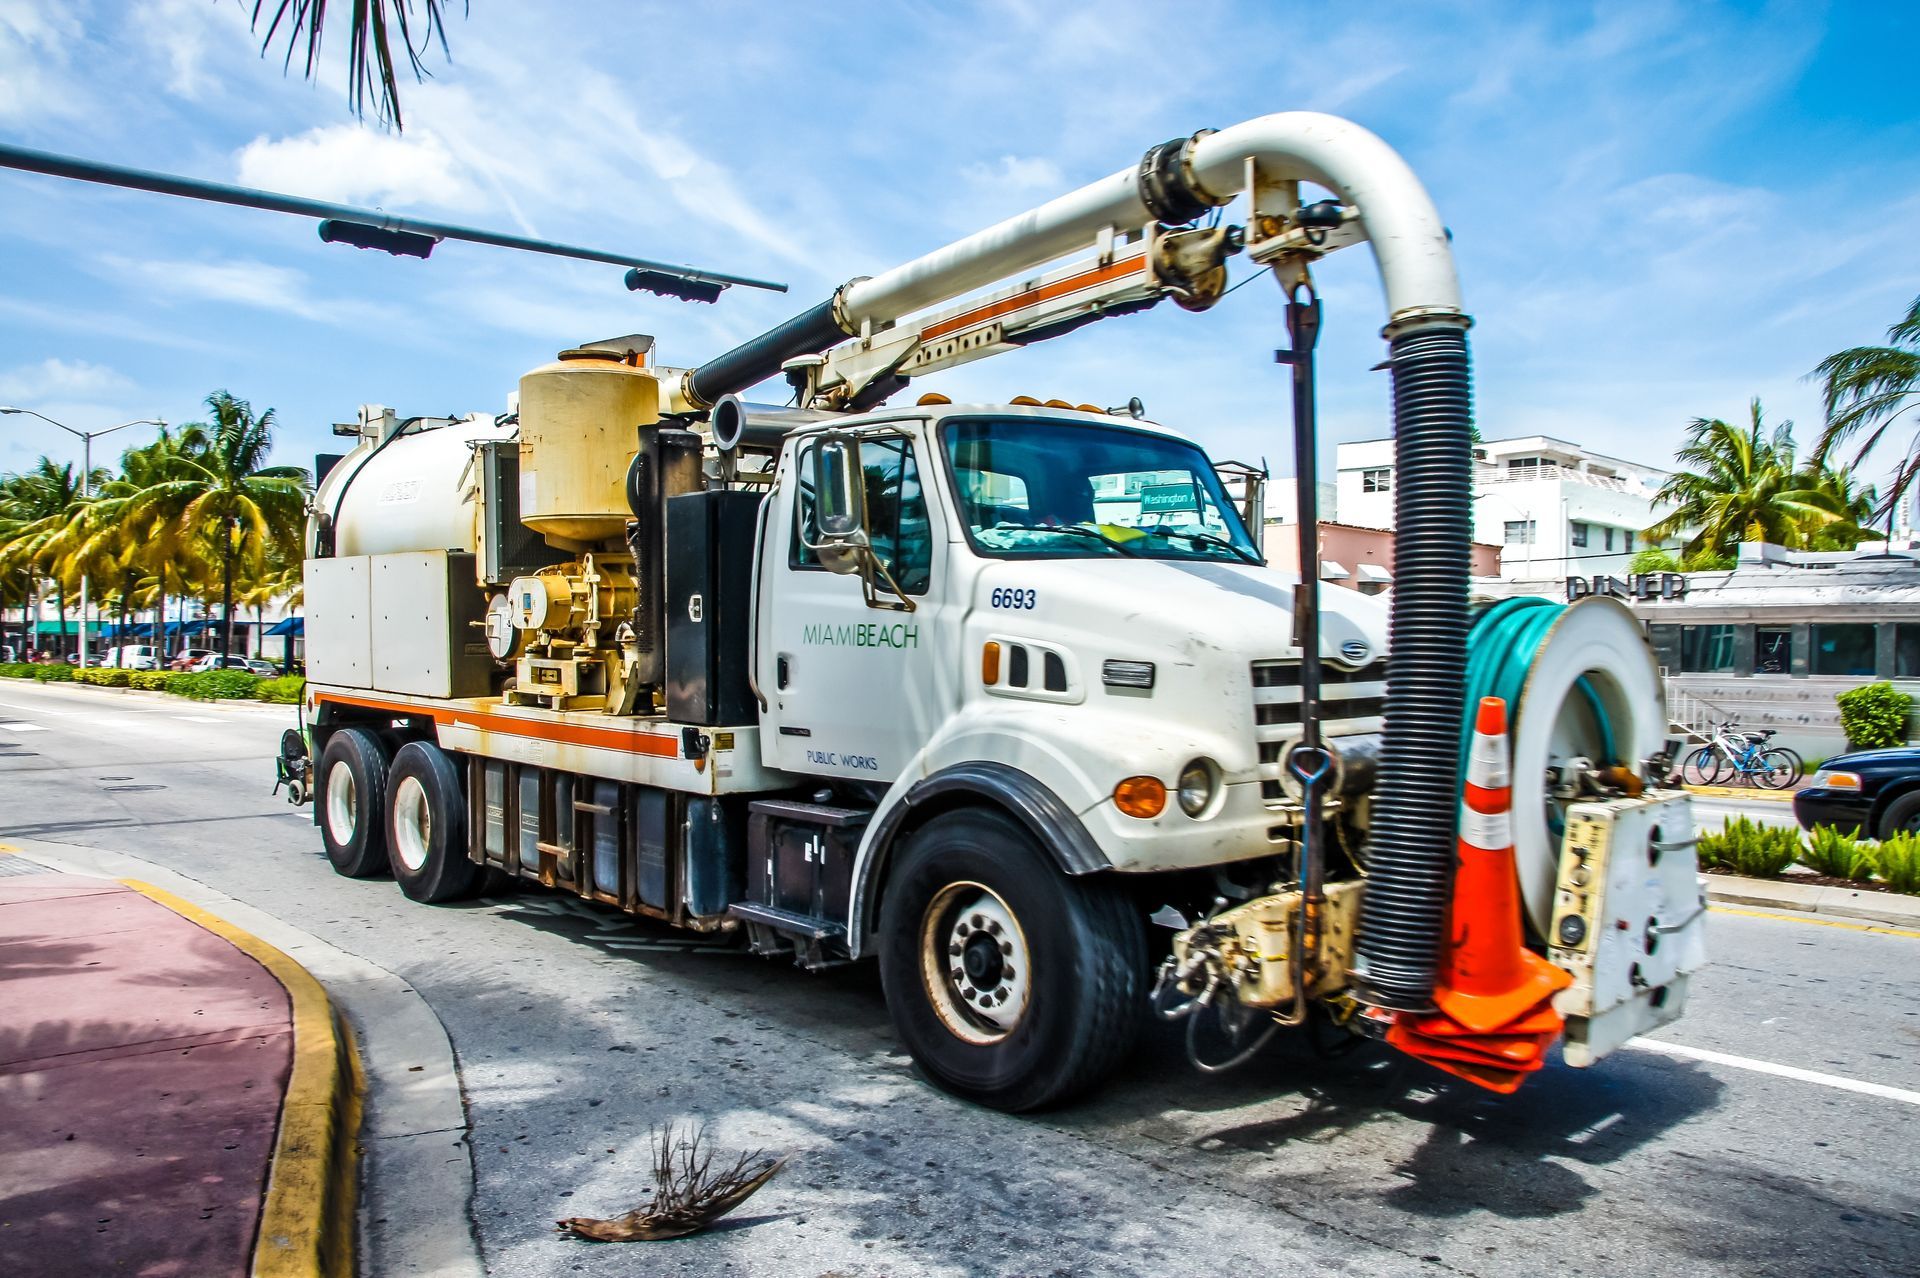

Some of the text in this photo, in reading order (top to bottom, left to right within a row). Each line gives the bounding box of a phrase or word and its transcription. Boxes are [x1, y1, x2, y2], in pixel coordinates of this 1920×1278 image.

[1144, 493, 1188, 506] Washington
[1566, 573, 1685, 600] DINER
[991, 587, 1036, 610] 6693
[807, 750, 878, 771] PUBLIC WORKS
